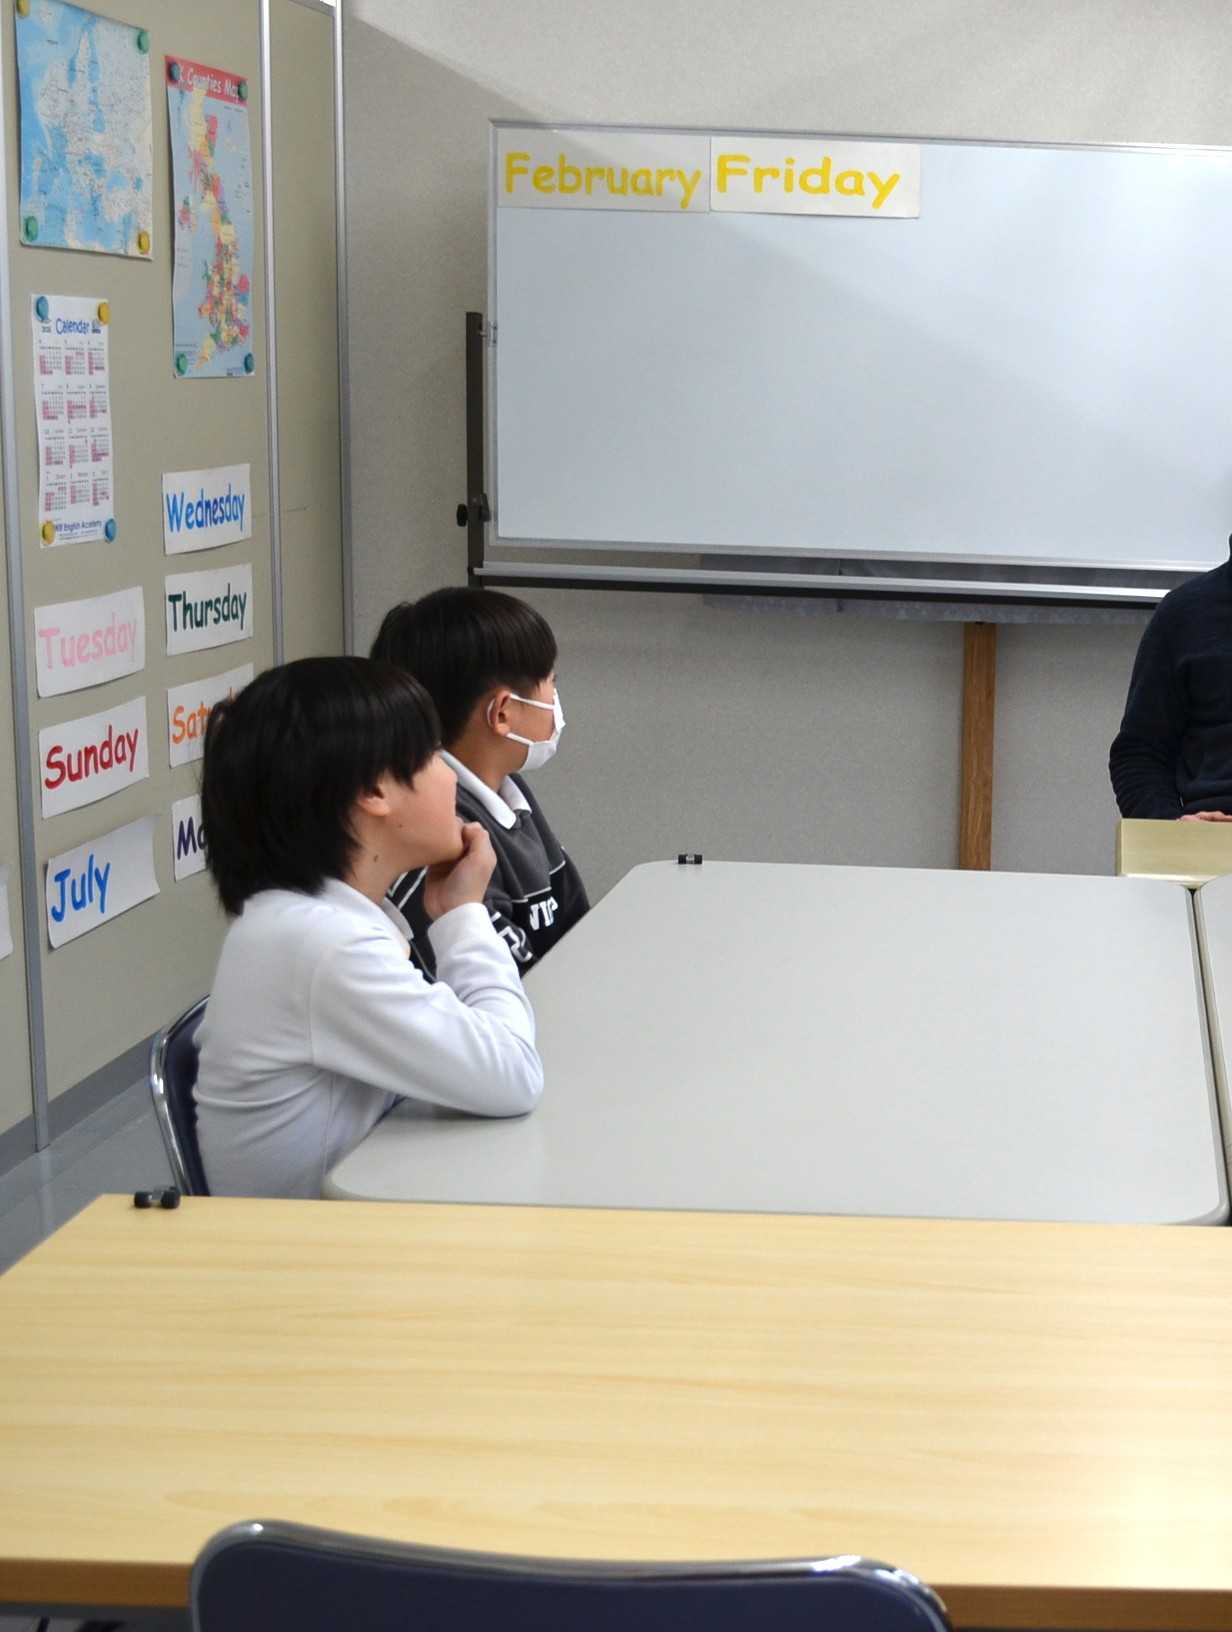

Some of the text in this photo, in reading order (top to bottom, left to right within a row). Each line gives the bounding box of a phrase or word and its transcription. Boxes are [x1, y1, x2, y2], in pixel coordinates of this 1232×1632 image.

[505, 152, 700, 208] February
[716, 152, 900, 208] Friday
[56, 317, 90, 334] Calendar
[166, 483, 246, 533] Wednesday
[168, 582, 247, 632] Thursday
[38, 611, 138, 669] Tuesday
[44, 725, 138, 790] Sunday
[51, 854, 111, 922] July
